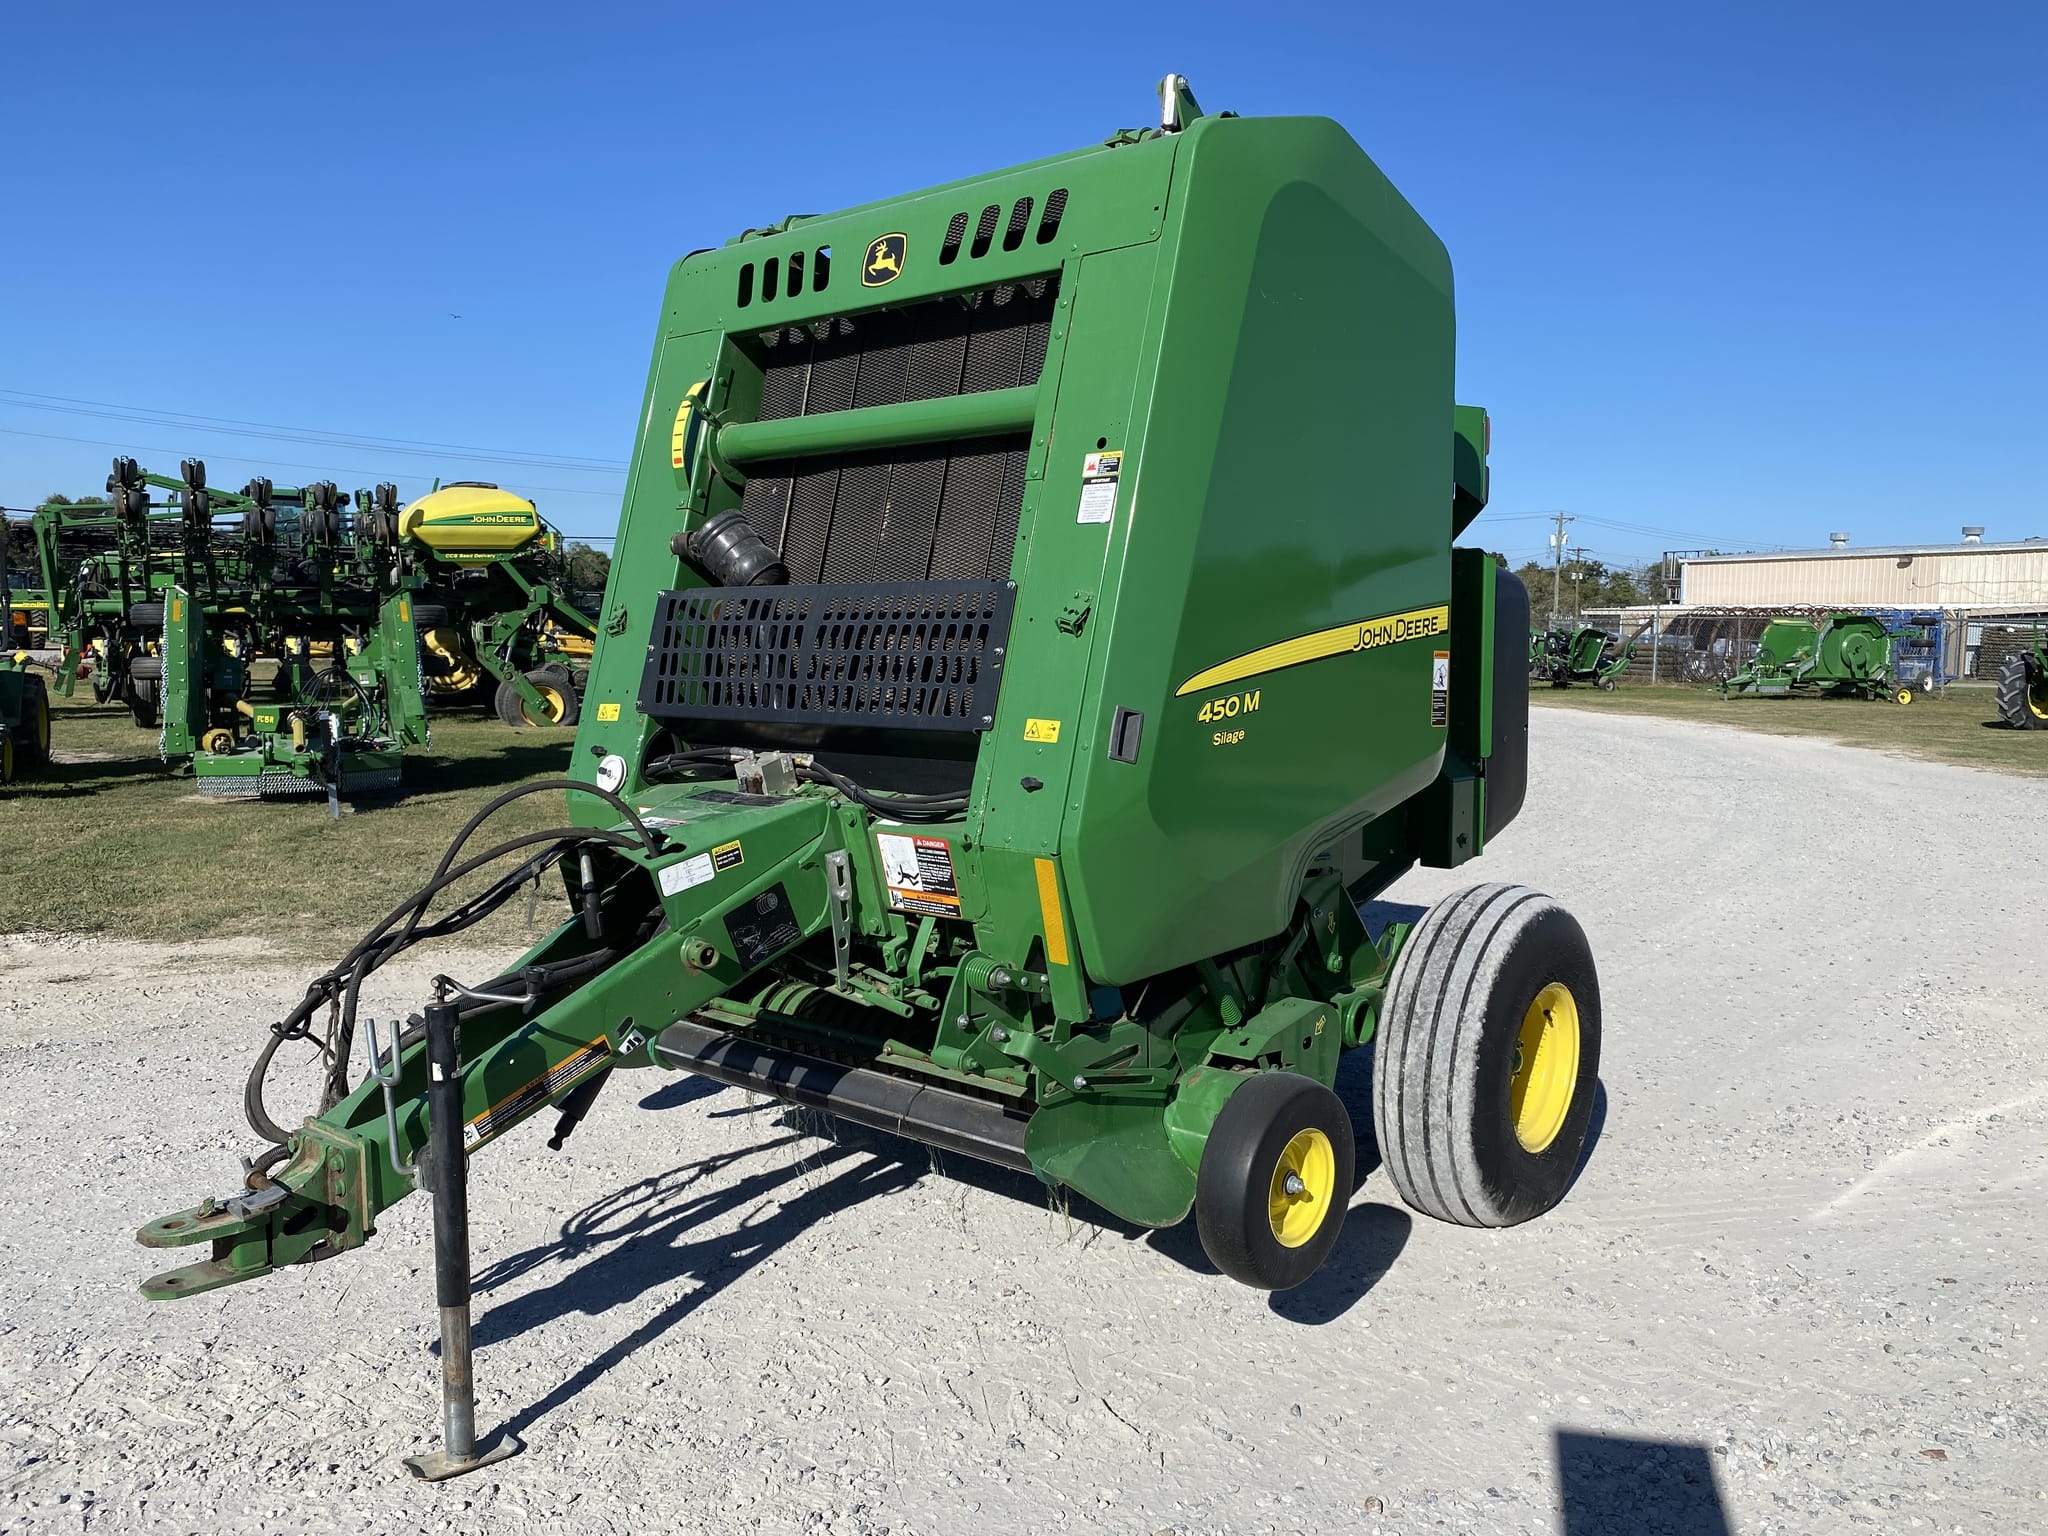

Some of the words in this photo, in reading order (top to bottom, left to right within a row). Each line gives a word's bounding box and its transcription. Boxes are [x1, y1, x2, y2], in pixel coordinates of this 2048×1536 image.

[470, 515, 495, 523] JOHN
[497, 515, 527, 523] DEERE
[1353, 623, 1393, 650] JOHN
[1395, 615, 1439, 640] DEERE
[1198, 695, 1240, 723] 450
[1243, 689, 1261, 713] M
[1212, 729, 1245, 746] Silage
[922, 839, 945, 848] DANGER
